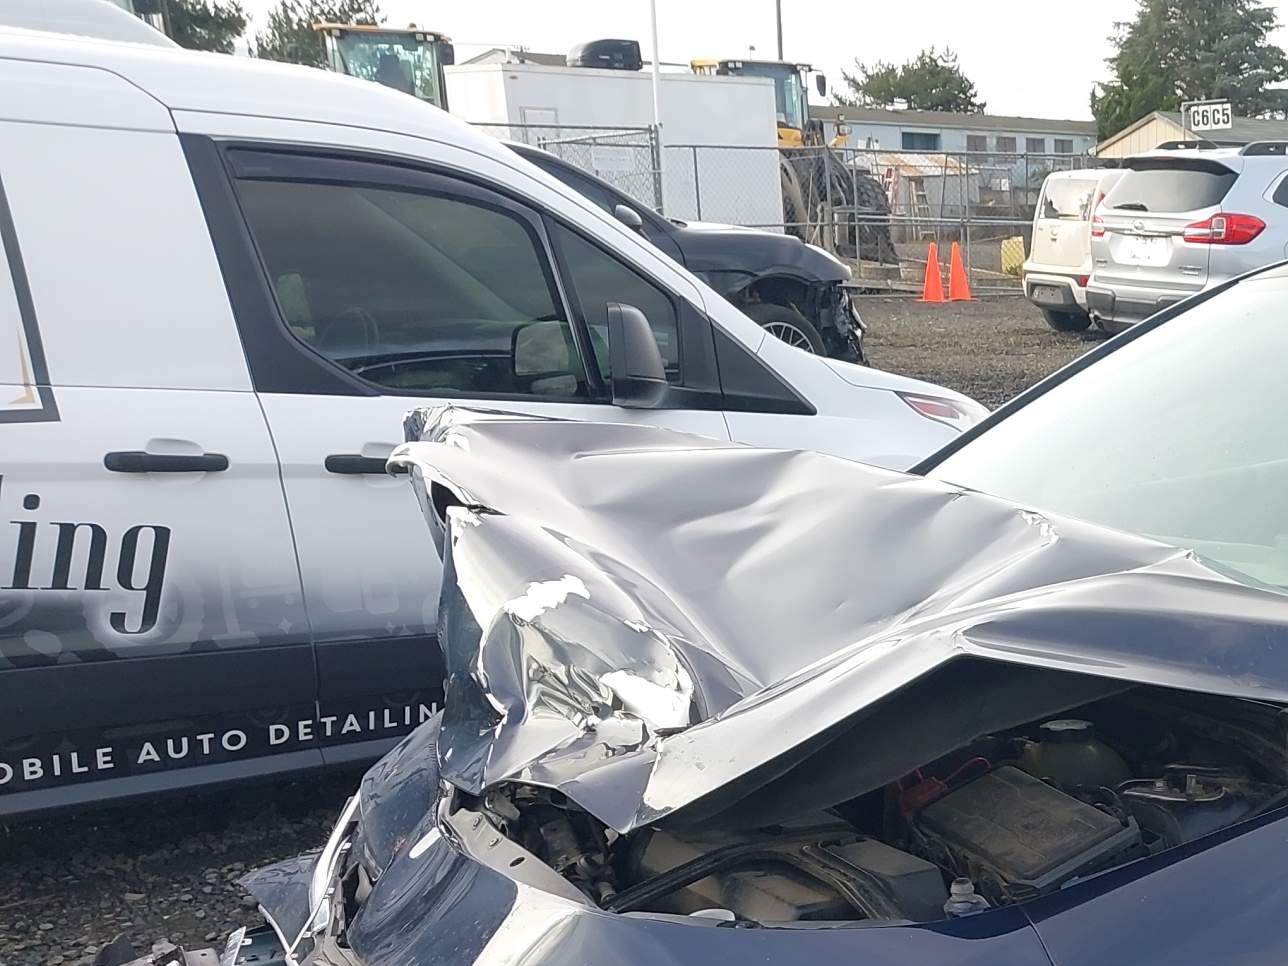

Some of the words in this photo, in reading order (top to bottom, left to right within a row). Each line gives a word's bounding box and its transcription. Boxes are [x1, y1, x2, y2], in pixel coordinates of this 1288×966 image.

[0, 482, 172, 635] ing
[0, 746, 115, 786] OBILE
[137, 729, 248, 764] AUTO
[268, 702, 438, 745] DETAILIN
